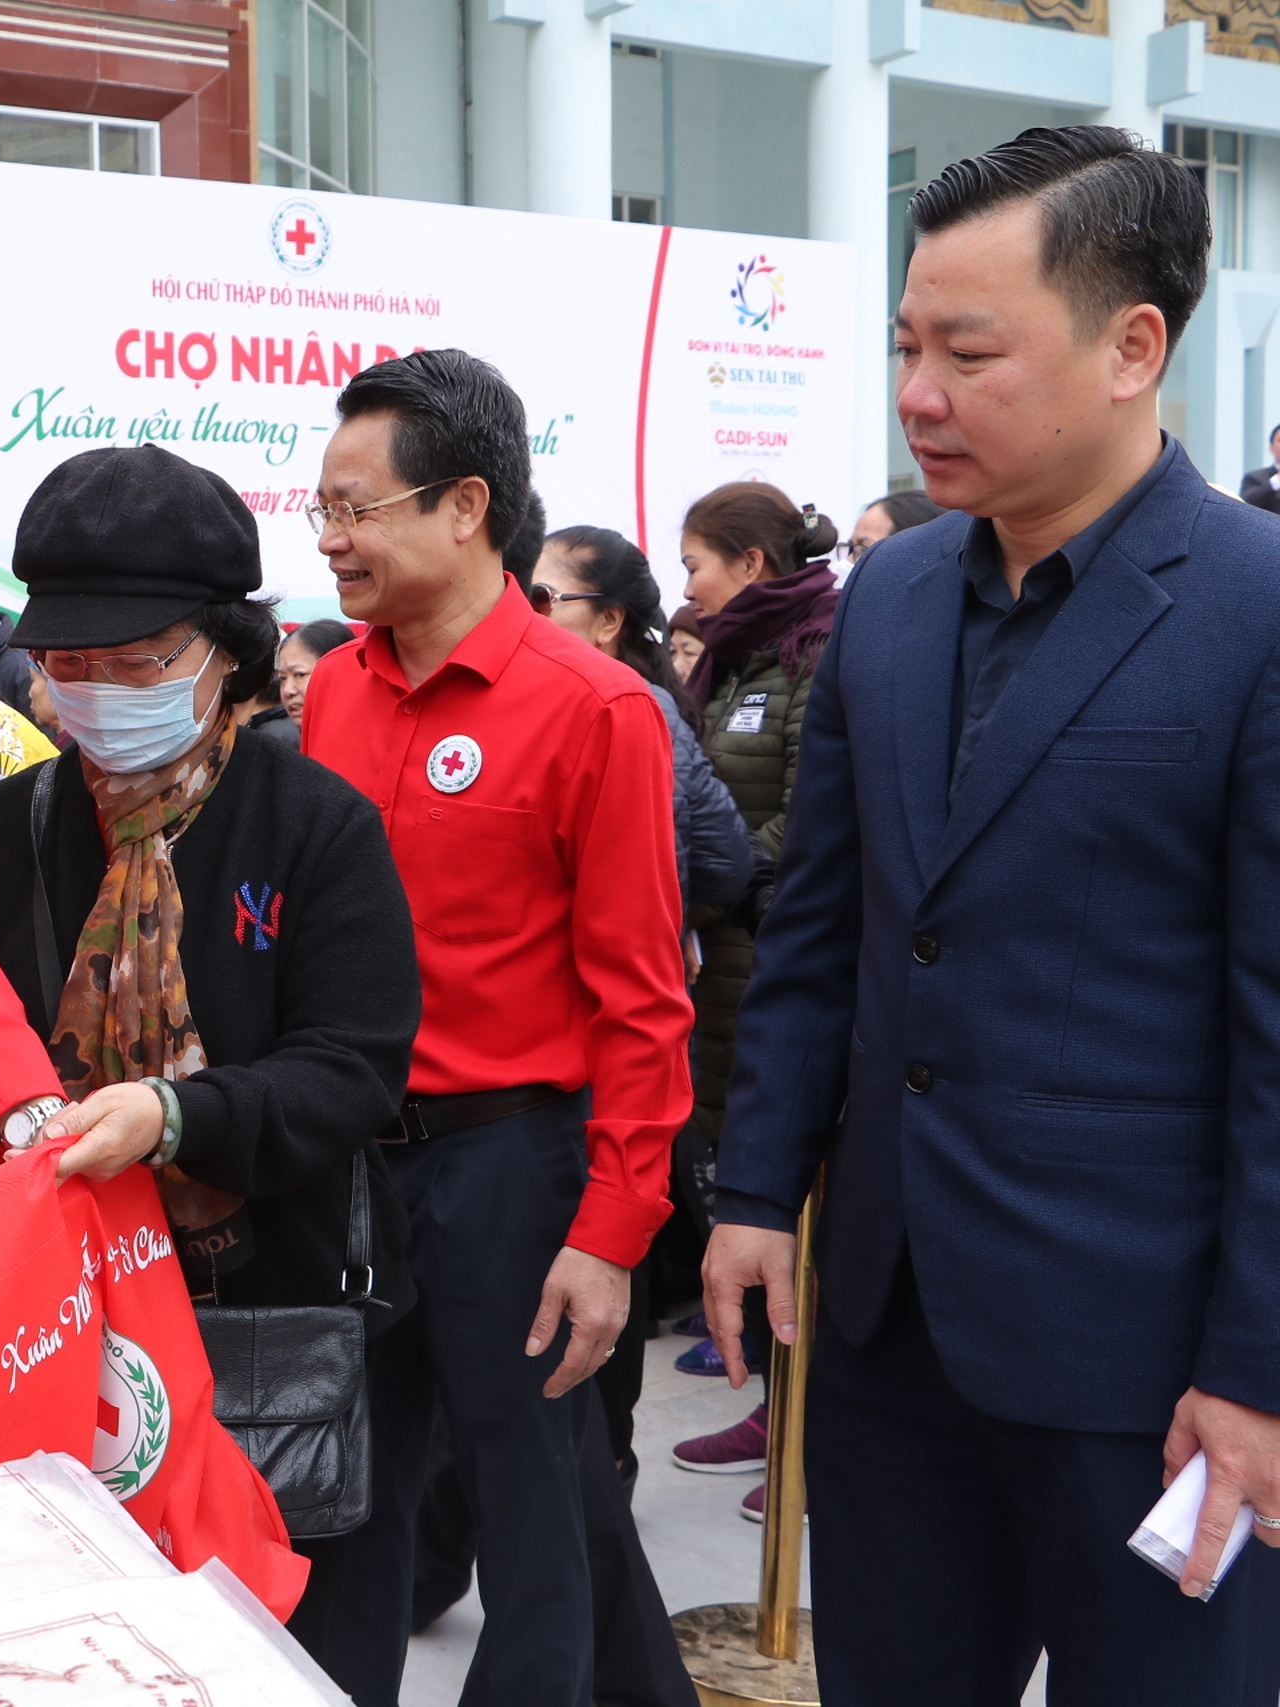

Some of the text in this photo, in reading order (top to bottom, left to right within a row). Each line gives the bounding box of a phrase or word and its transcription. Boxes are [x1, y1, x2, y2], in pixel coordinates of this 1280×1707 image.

[152, 274, 440, 320] HỘI CHỮ THẬP ĐỎ THÀNH PHỐ HÀ NỘI
[115, 328, 360, 389] CHỢ NHÂN
[730, 367, 753, 382] SEN
[782, 370, 805, 385] THU
[191, 402, 298, 465] thương
[715, 429, 788, 447] CADI-SUN
[284, 488, 308, 512] 27
[1, 1325, 63, 1393] Xuân
